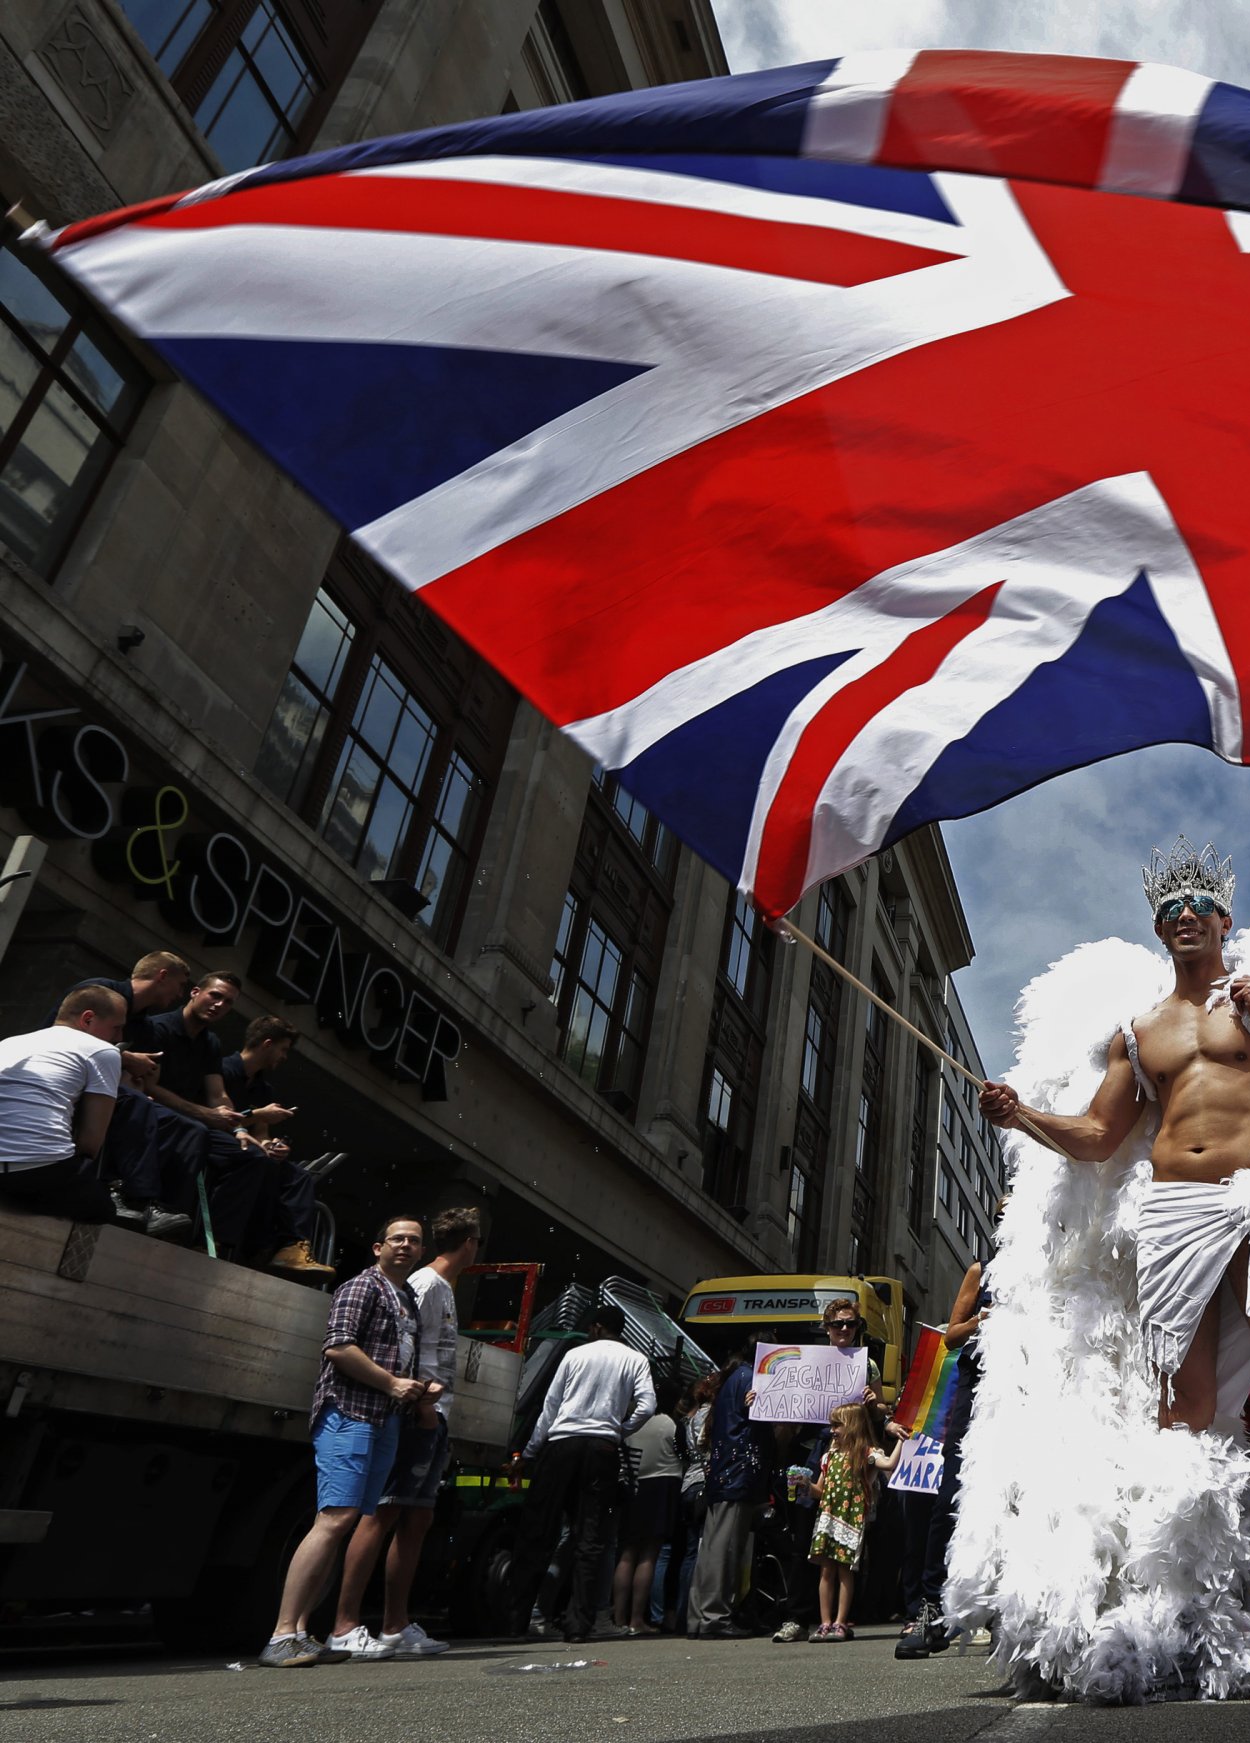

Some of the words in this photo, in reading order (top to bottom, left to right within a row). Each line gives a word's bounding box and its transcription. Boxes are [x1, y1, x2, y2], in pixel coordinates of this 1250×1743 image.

[126, 785, 189, 901] &
[190, 832, 462, 1096] SPENCER
[703, 1300, 729, 1311] CSL
[762, 1363, 861, 1396] LEGALLY
